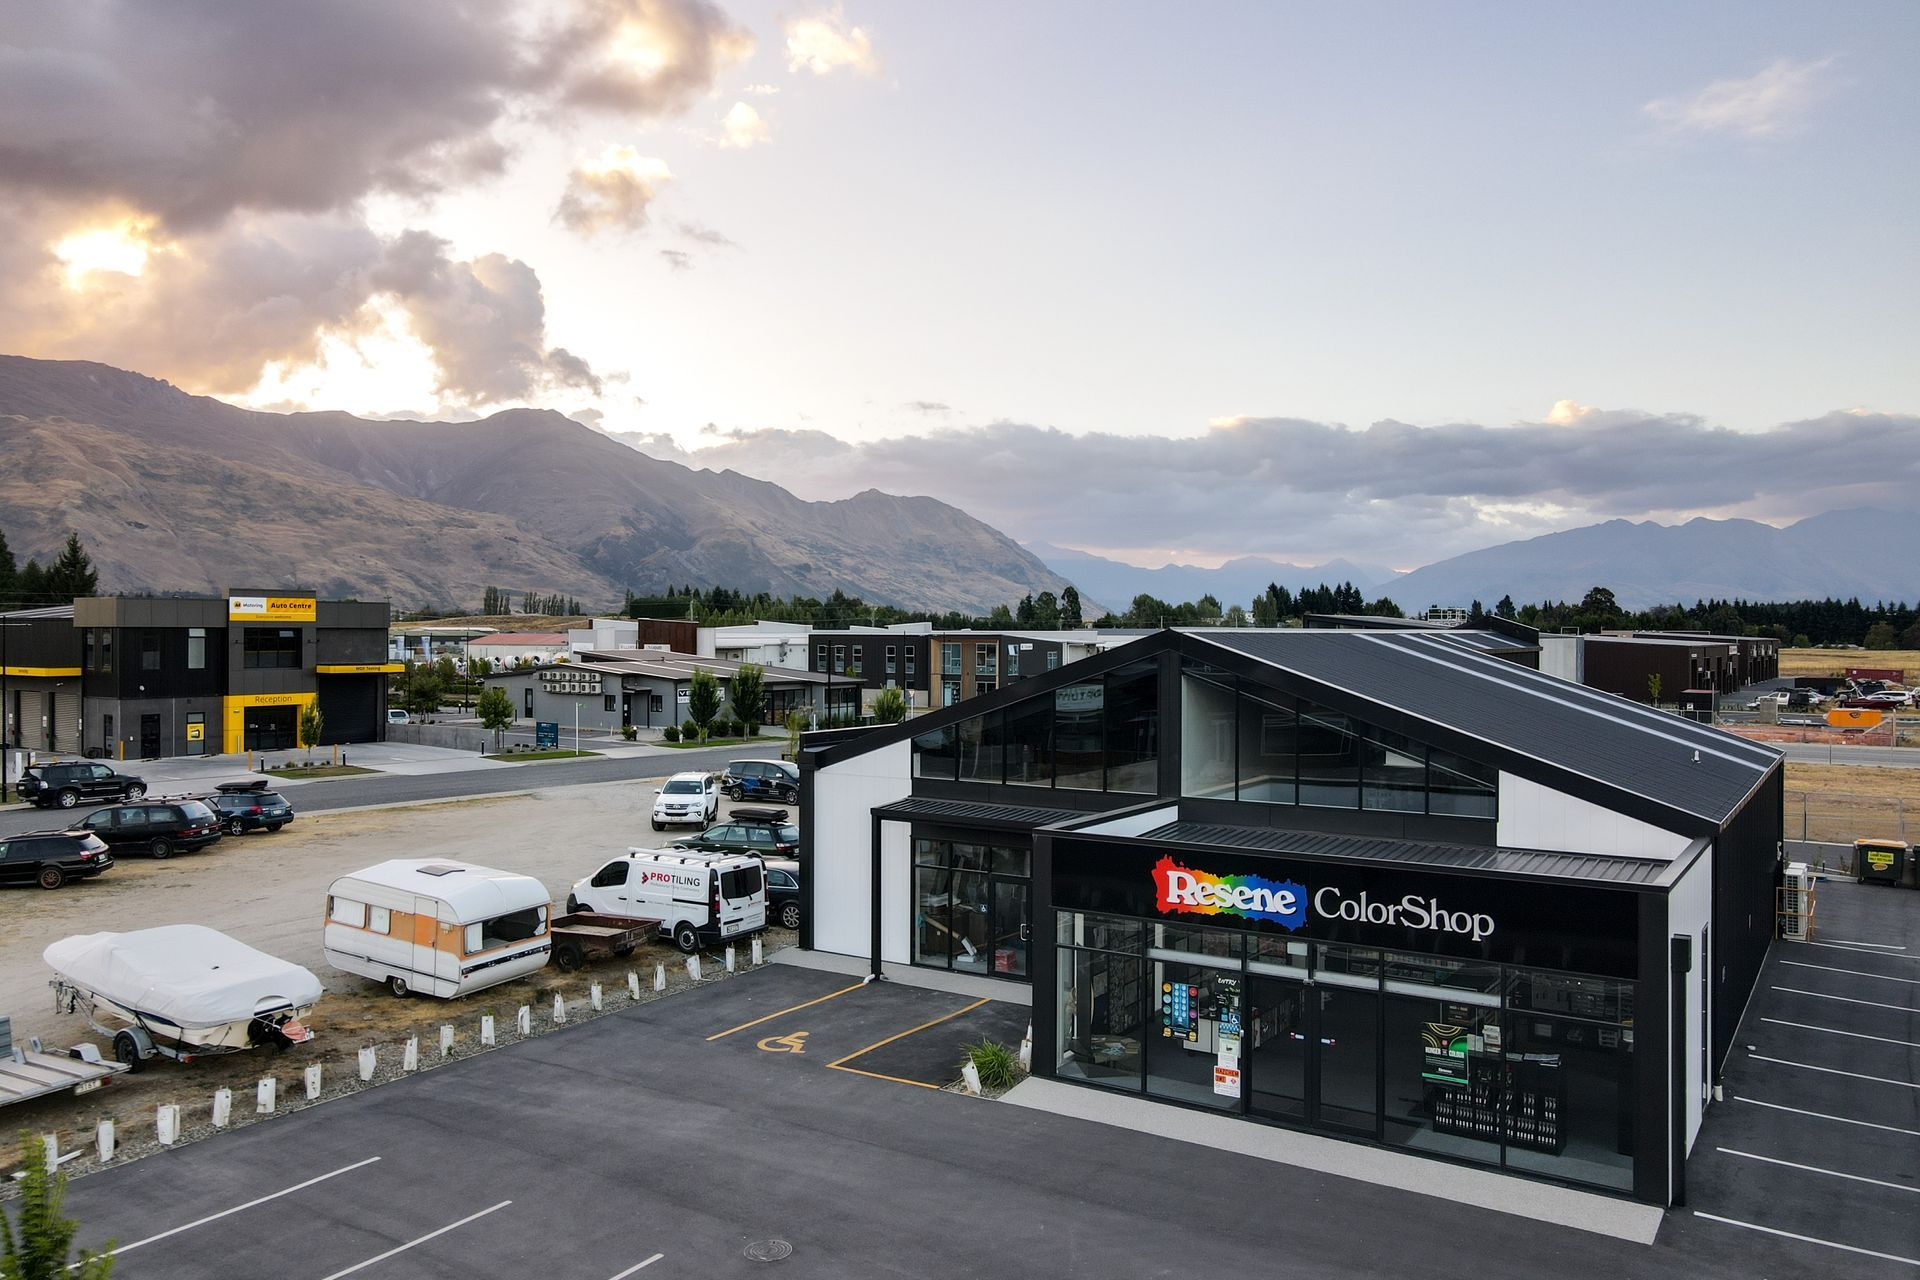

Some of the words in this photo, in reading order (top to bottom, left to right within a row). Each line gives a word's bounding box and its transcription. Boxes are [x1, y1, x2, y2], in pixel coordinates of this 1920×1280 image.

[255, 696, 293, 704] Reception
[650, 872, 700, 887] PROTILING
[1165, 870, 1298, 915] Resene
[1314, 886, 1496, 942] ColorShop
